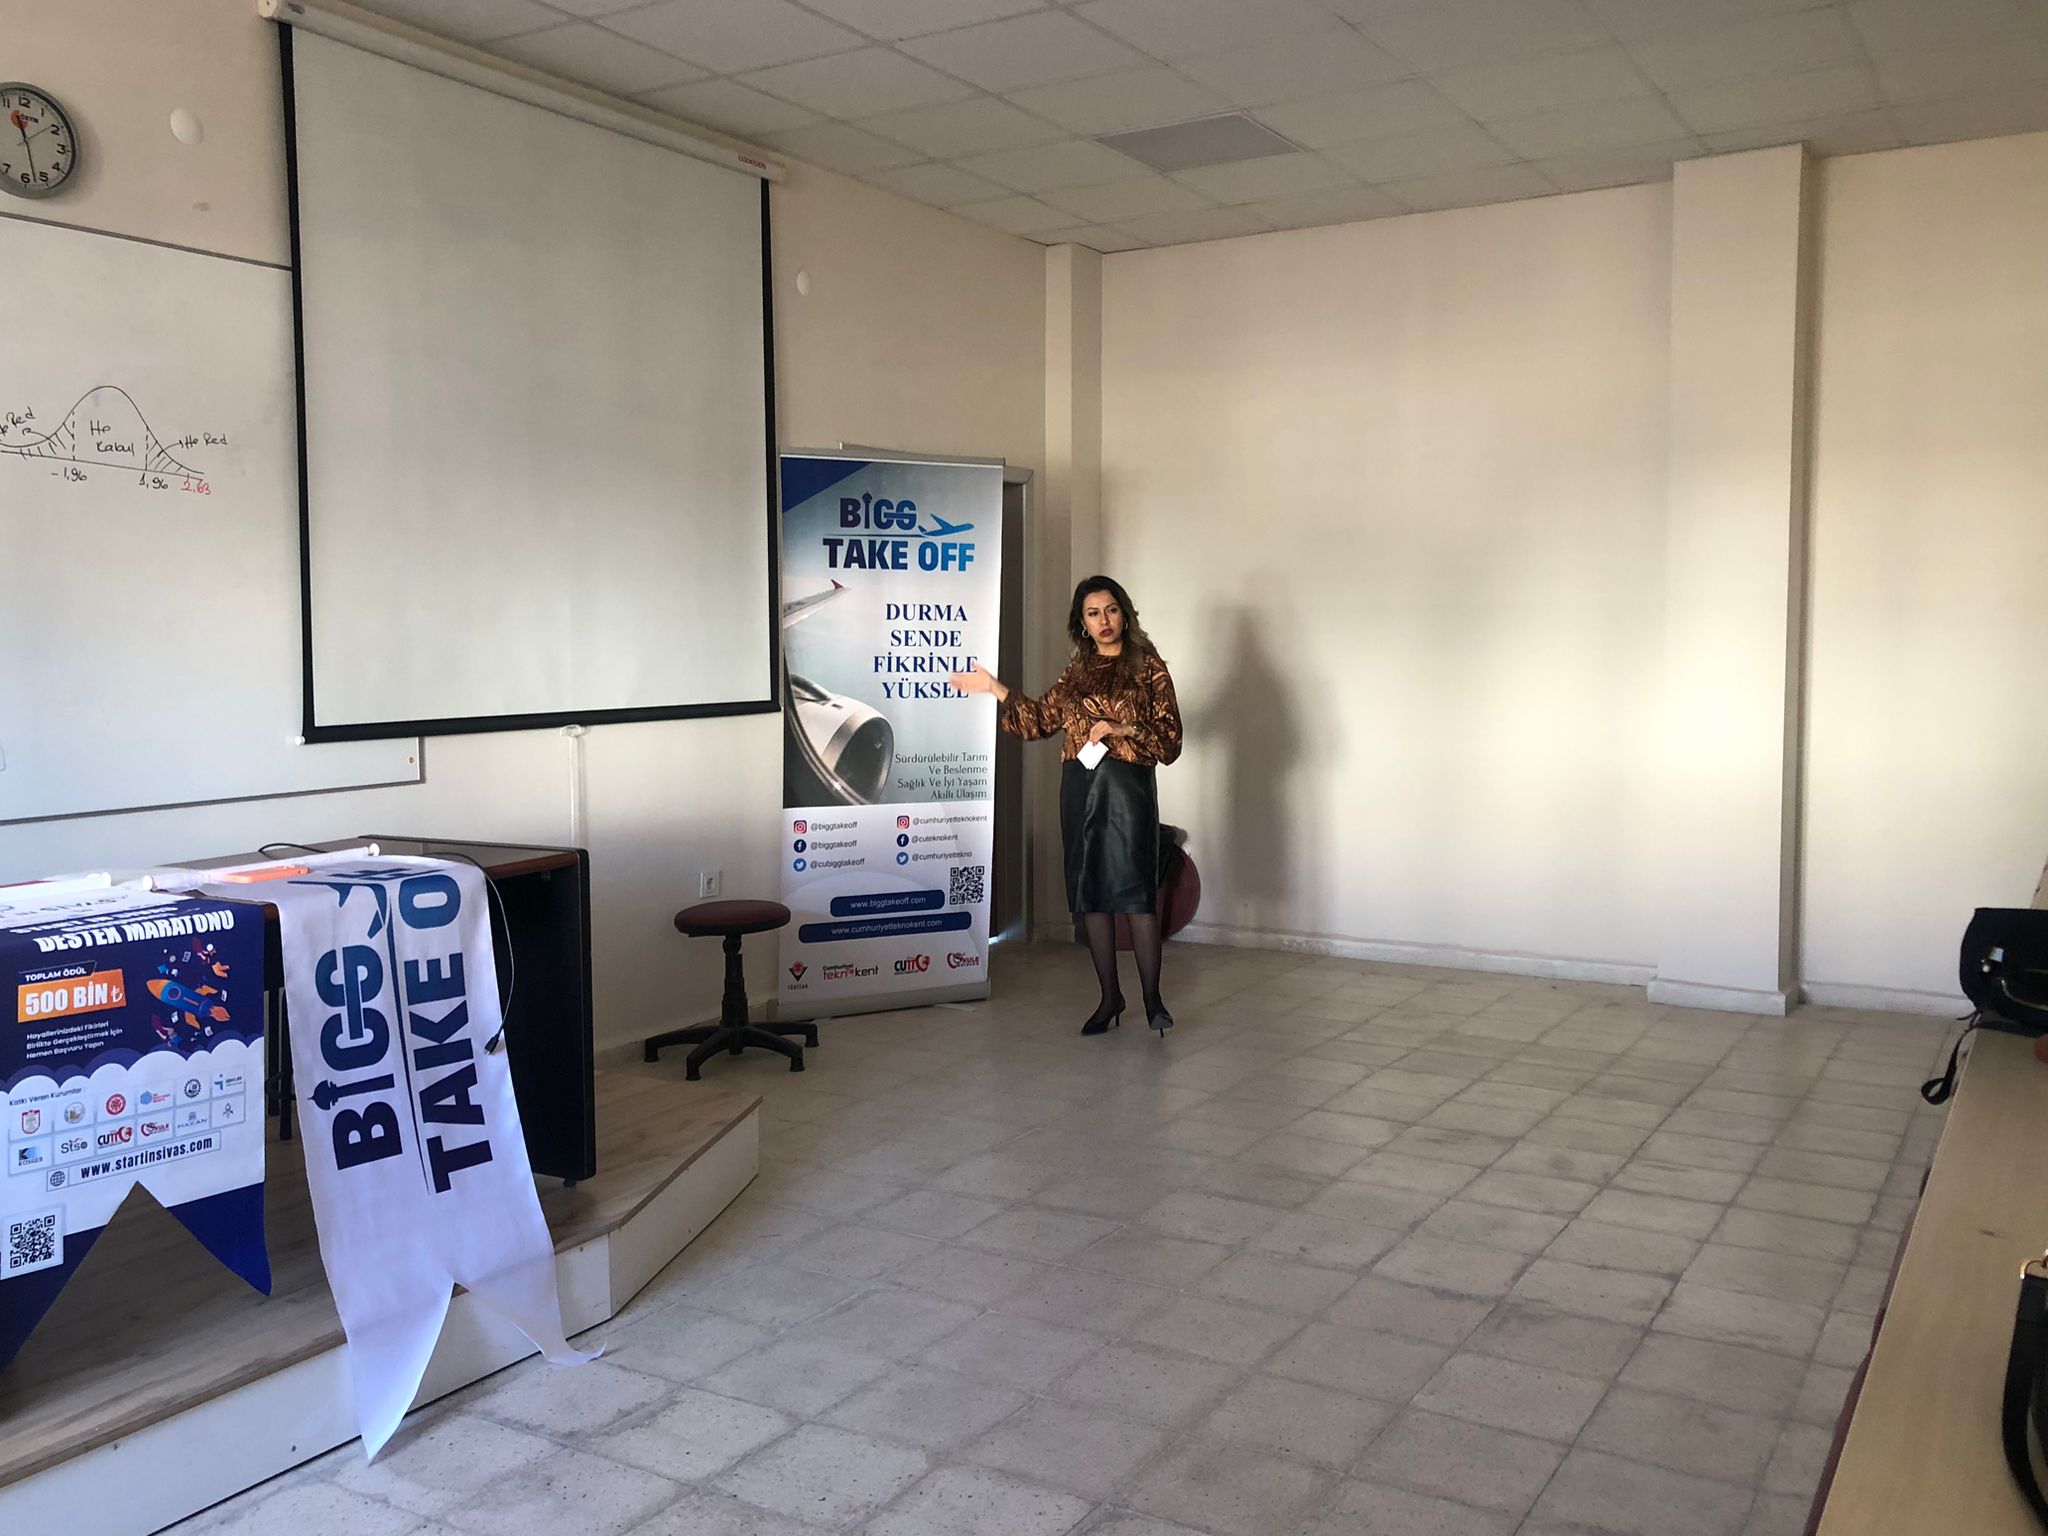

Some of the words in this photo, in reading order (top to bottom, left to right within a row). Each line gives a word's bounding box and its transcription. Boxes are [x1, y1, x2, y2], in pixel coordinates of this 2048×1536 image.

[18, 95, 31, 108] 12
[40, 107, 45, 117] 1
[50, 123, 61, 136] 2
[56, 143, 67, 155] 3
[2, 162, 12, 174] 7
[52, 161, 62, 172] 4
[20, 172, 31, 184] 6
[38, 171, 49, 182] 5
[823, 538, 909, 570] TAKE
[918, 541, 976, 572] OFF
[886, 603, 968, 622] DURMA
[890, 629, 962, 647] SENDE
[873, 651, 978, 673] FİKRİNLE
[895, 753, 959, 763] Sürdürülebilir
[929, 765, 941, 775] Ve
[943, 764, 988, 775] Beslenme
[897, 778, 926, 790] Sağlık
[929, 777, 941, 787] Ve
[958, 777, 987, 788] Yaşam
[811, 821, 858, 832] @biggtakeoff
[913, 815, 987, 826] @cumhuriyetteknokent
[811, 840, 857, 851] @biggtakeoff
[912, 834, 958, 844] @cuteknokent
[810, 858, 865, 870] @cubiggtakeoff
[851, 896, 926, 910] www.biggtakeoff.com
[33, 930, 122, 953] DESTEK
[121, 909, 235, 942] MARATONU
[832, 919, 942, 936] www.cumhuriyetteknokent.com
[25, 971, 61, 982] TOPLAM
[63, 966, 86, 977] ÖDÜL
[25, 988, 68, 1016] 500
[73, 981, 108, 1009] BİN
[403, 952, 494, 1194] TAKE
[80, 1137, 213, 1180] www.startinsivas.com
